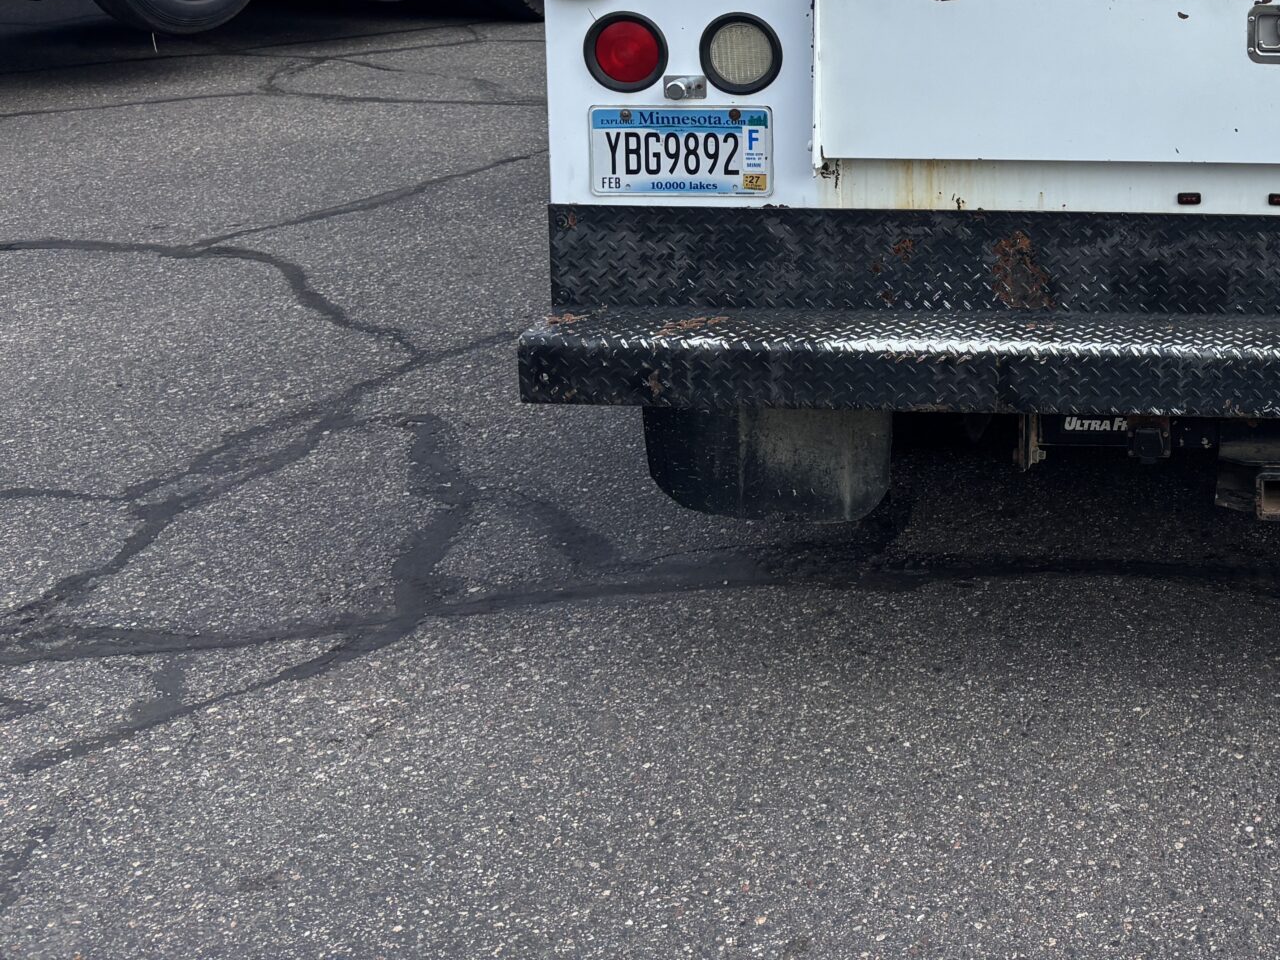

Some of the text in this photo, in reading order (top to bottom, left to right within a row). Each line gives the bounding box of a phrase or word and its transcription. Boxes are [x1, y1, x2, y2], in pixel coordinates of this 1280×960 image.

[747, 129, 759, 151] F
[605, 131, 740, 175] YBG9892
[602, 177, 621, 189] FEB
[650, 181, 718, 190] 10,000 lakes
[1064, 416, 1111, 431] ULTRA
